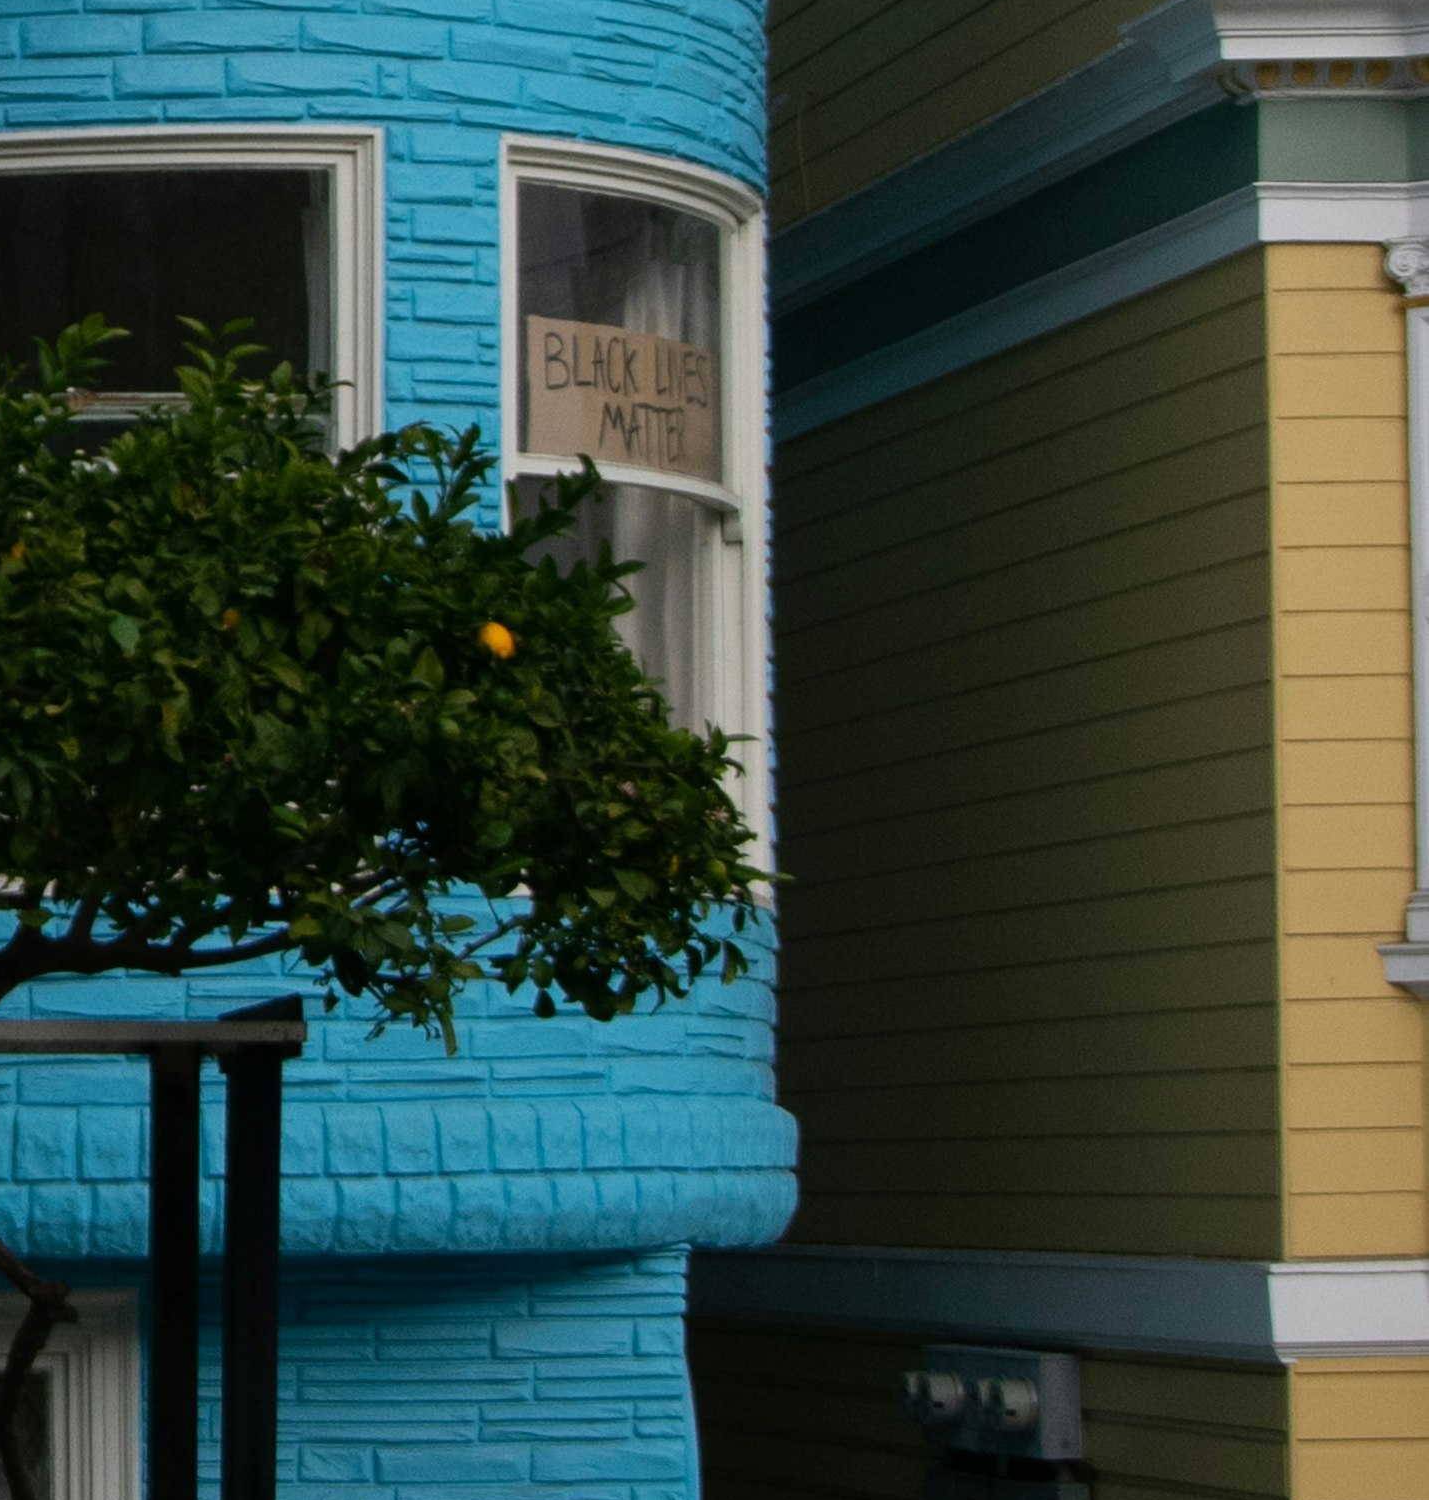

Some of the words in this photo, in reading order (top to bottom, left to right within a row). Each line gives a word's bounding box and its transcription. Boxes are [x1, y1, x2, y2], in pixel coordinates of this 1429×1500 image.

[543, 331, 639, 397] BLACK
[655, 343, 709, 408] LIVES
[598, 402, 686, 463] MATTER
